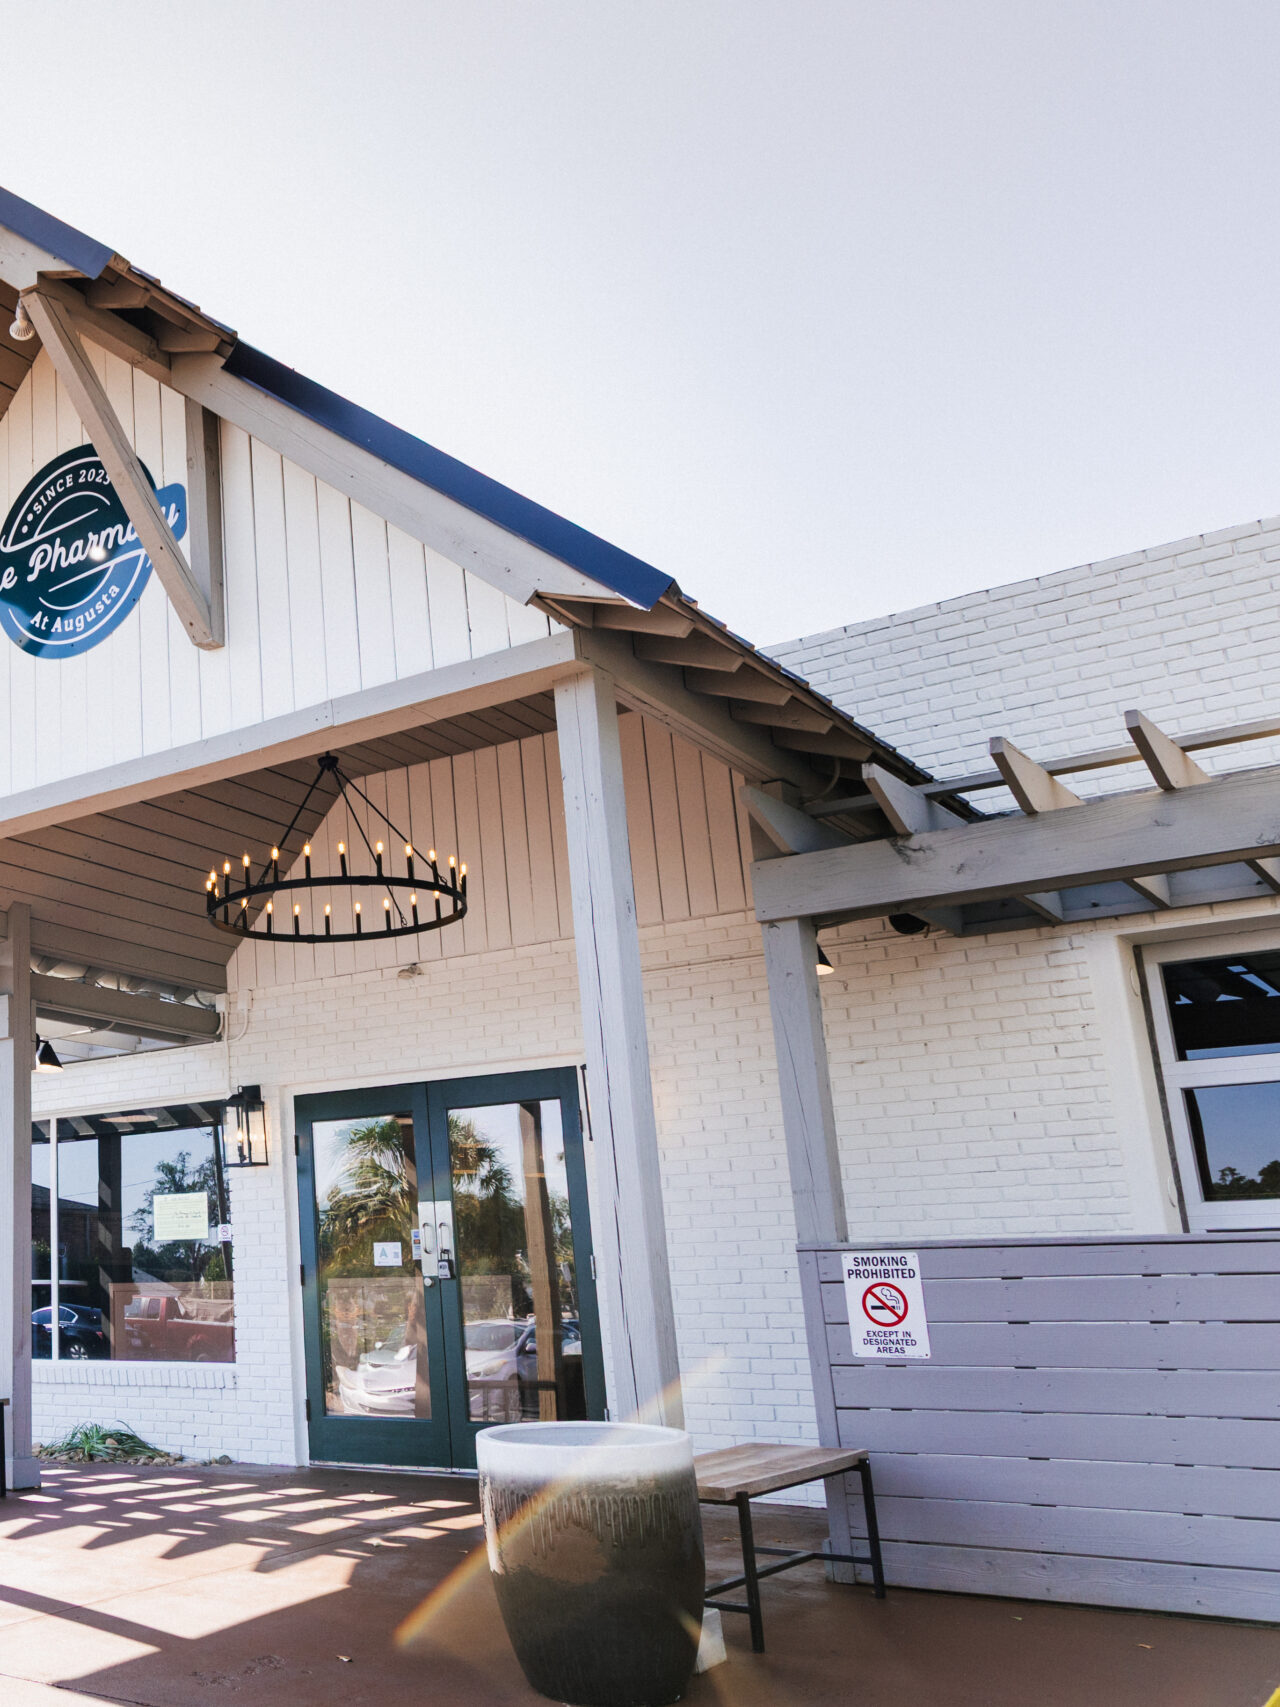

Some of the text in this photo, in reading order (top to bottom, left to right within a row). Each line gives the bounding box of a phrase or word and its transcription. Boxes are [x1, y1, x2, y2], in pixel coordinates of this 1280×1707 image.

[33, 474, 73, 515] SINCE
[30, 584, 120, 633] At Augusta
[853, 1256, 908, 1267] SMOKING
[847, 1268, 916, 1279] PROHIBITED
[866, 1330, 899, 1338] EXCEPT
[863, 1338, 917, 1346] DESIGNATED
[876, 1346, 906, 1354] AREAS
